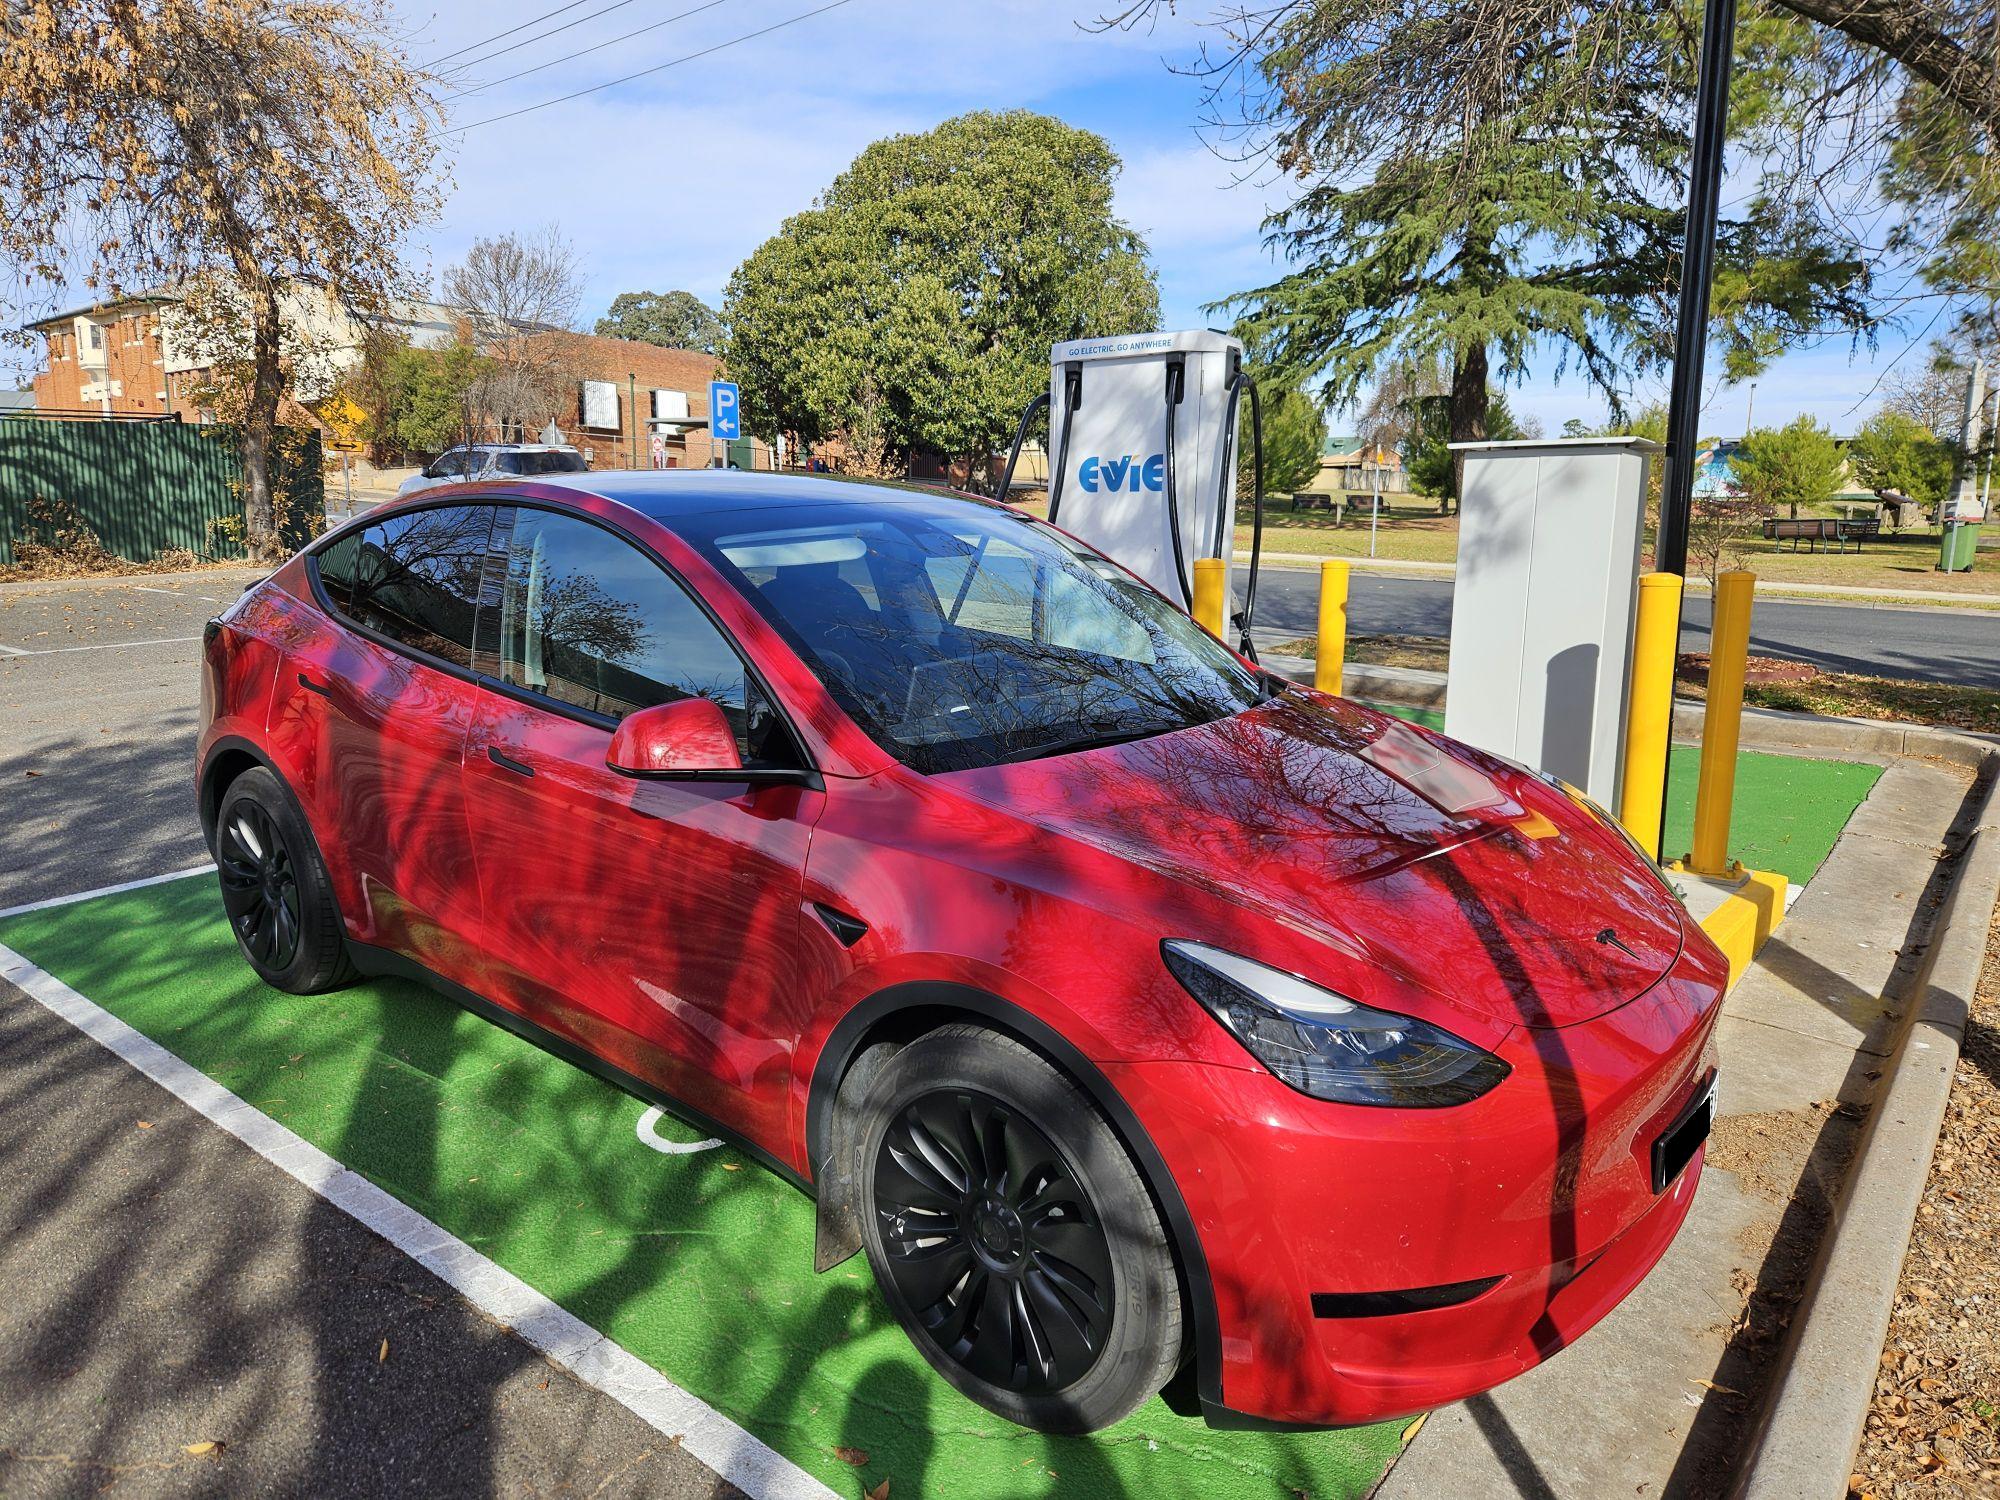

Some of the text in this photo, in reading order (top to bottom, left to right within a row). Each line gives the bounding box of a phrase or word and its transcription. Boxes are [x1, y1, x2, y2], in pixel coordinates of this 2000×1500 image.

[1068, 339, 1172, 356] GO ELECTRIC. GO ANYWHERE
[716, 388, 735, 418] P
